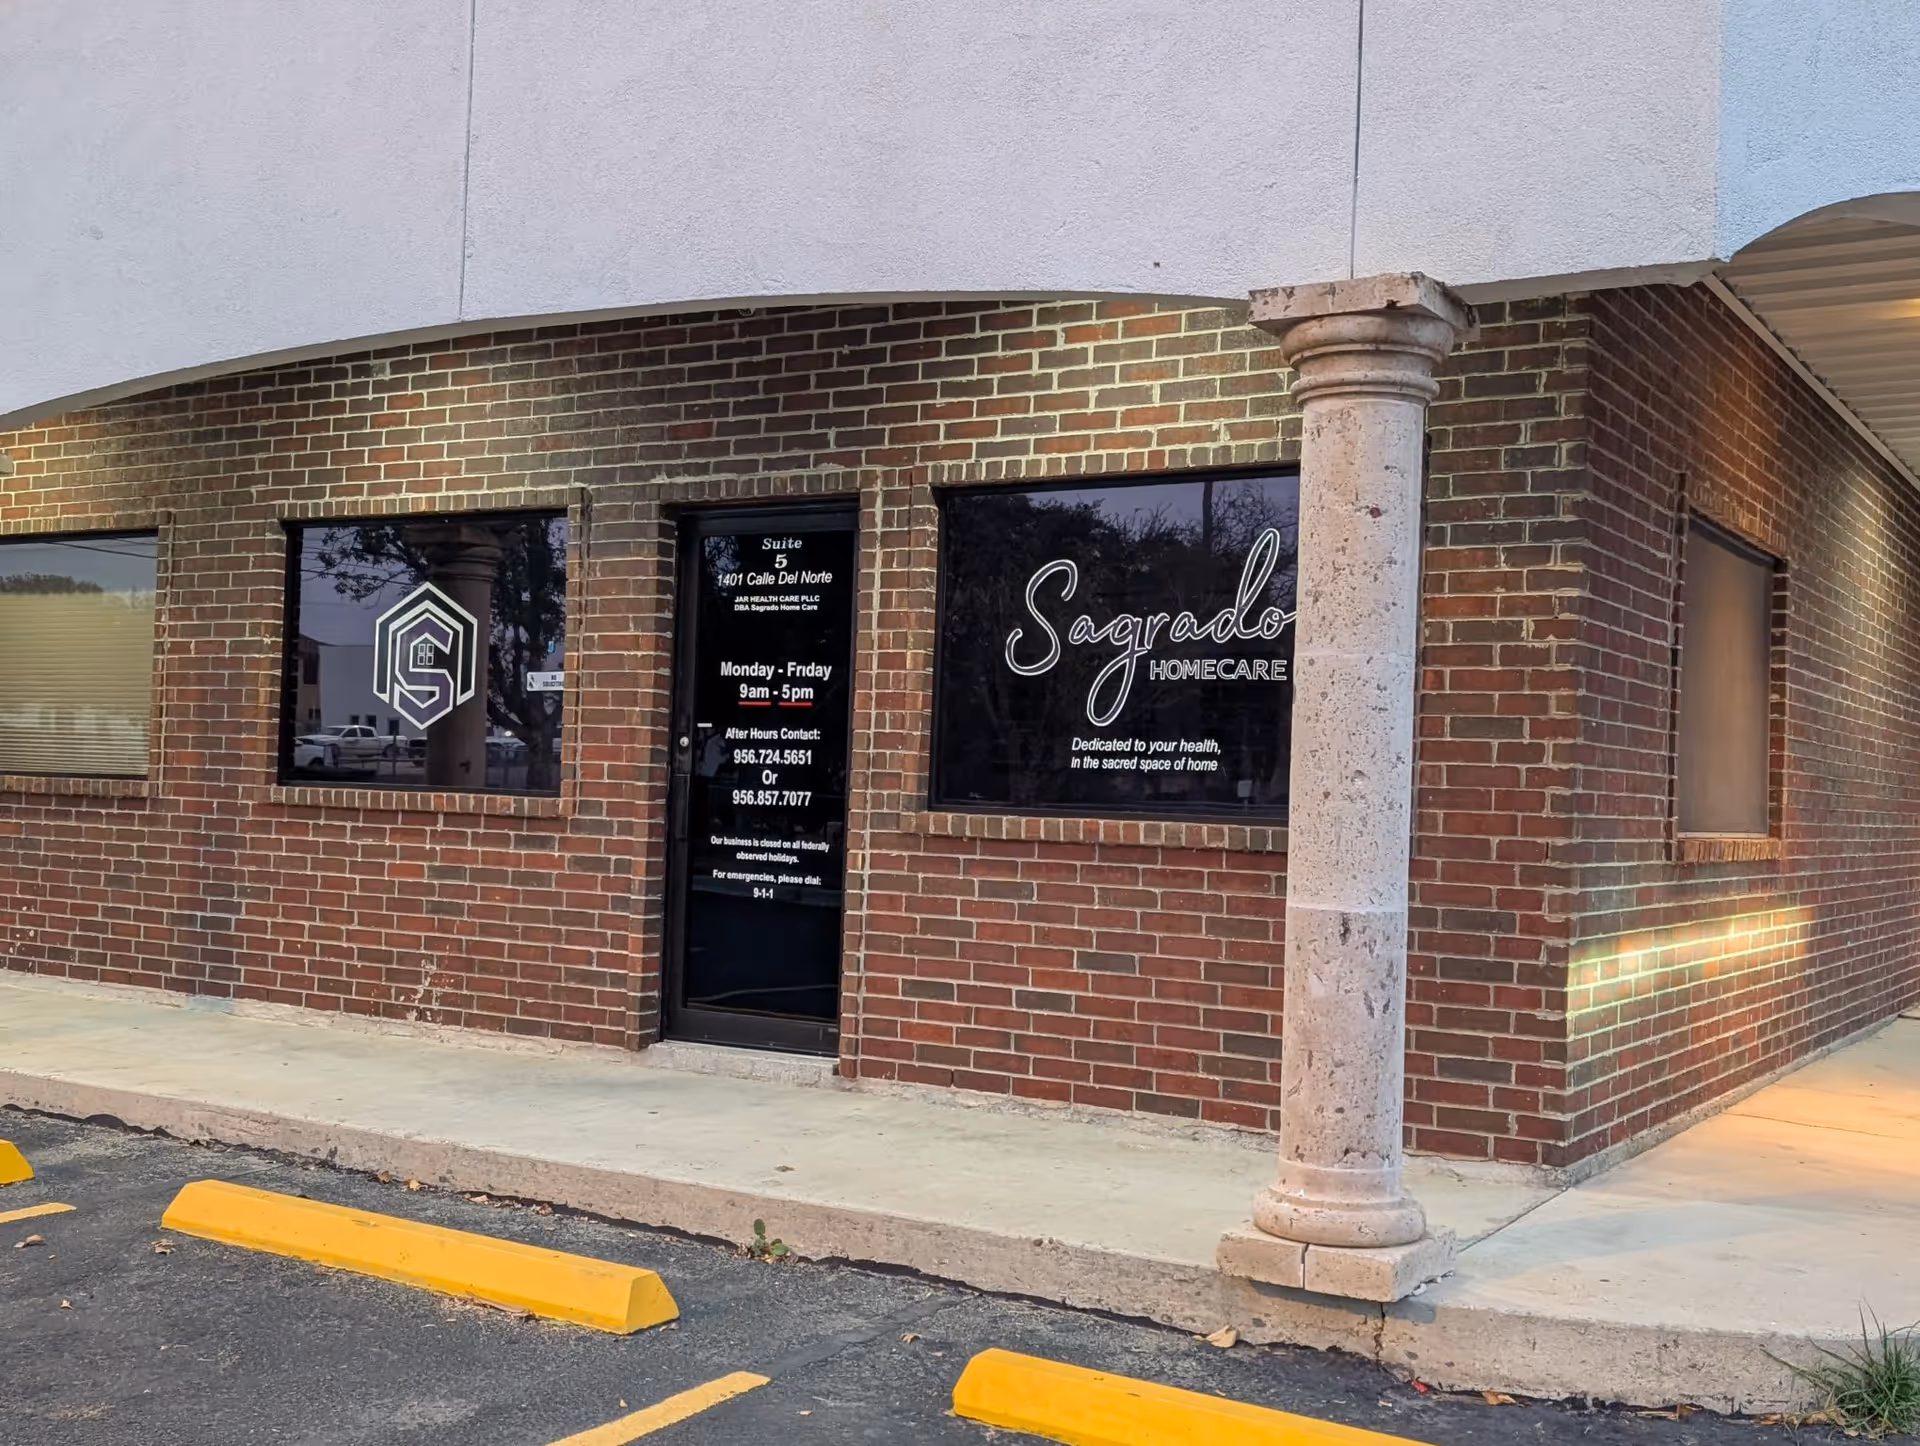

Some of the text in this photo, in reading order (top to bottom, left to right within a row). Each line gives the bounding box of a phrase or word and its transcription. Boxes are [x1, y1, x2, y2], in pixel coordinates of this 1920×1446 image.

[762, 537, 802, 550] Suite
[774, 554, 788, 568] 5
[717, 571, 833, 587] 1401 Calle Del Norte
[750, 604, 779, 612] Sagrado
[1005, 528, 1297, 727] Sagrado
[720, 662, 775, 680] Monday
[787, 662, 832, 681] Friday
[1149, 658, 1288, 681] HOMECARE
[739, 683, 769, 698] 9am
[782, 684, 814, 702] 5pm
[725, 728, 821, 740] After Hours Contact:
[1072, 737, 1222, 755] Dedicated to your health,
[733, 750, 812, 765] 956.724.5651
[1082, 757, 1099, 769] the
[1101, 757, 1137, 769] sacred
[1139, 759, 1172, 773] space
[1174, 757, 1186, 770] of
[1187, 757, 1218, 771] home
[762, 770, 778, 785] Or
[732, 790, 812, 806] 956.857.7077
[711, 836, 830, 853] Our business is closed on all federally
[736, 851, 800, 865] observed holidays.
[713, 869, 822, 885] For emergencies, please dial:
[753, 888, 774, 899] 9-1-1
